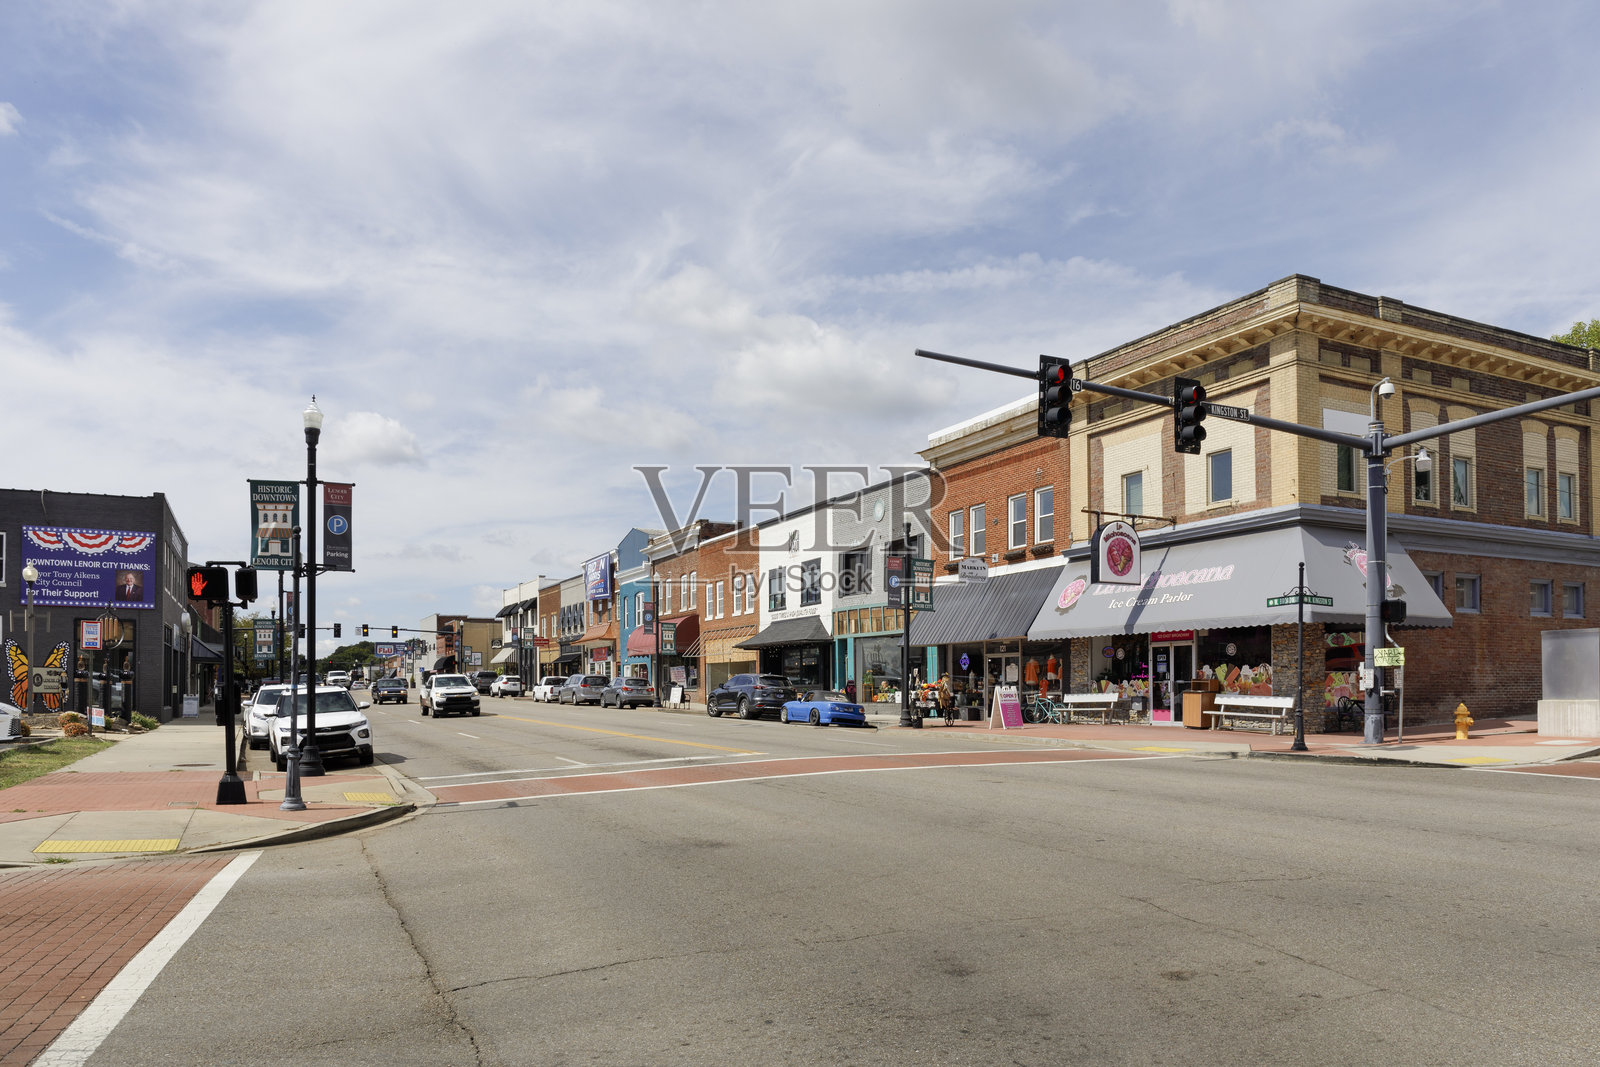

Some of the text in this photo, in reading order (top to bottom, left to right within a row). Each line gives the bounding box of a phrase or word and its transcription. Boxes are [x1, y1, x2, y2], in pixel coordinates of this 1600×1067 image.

[1211, 404, 1238, 417] KINGSTON
[258, 485, 292, 494] HISTORIC
[333, 518, 343, 532] P
[26, 558, 151, 571] DOWNTOWN LENOIR CITY THANKS:
[53, 571, 72, 579] Tony
[74, 572, 100, 580] Aikens
[35, 579, 50, 587] City
[41, 588, 62, 597] Their
[64, 589, 99, 599] Support!
[1108, 592, 1193, 609] Ice Cream Parlor
